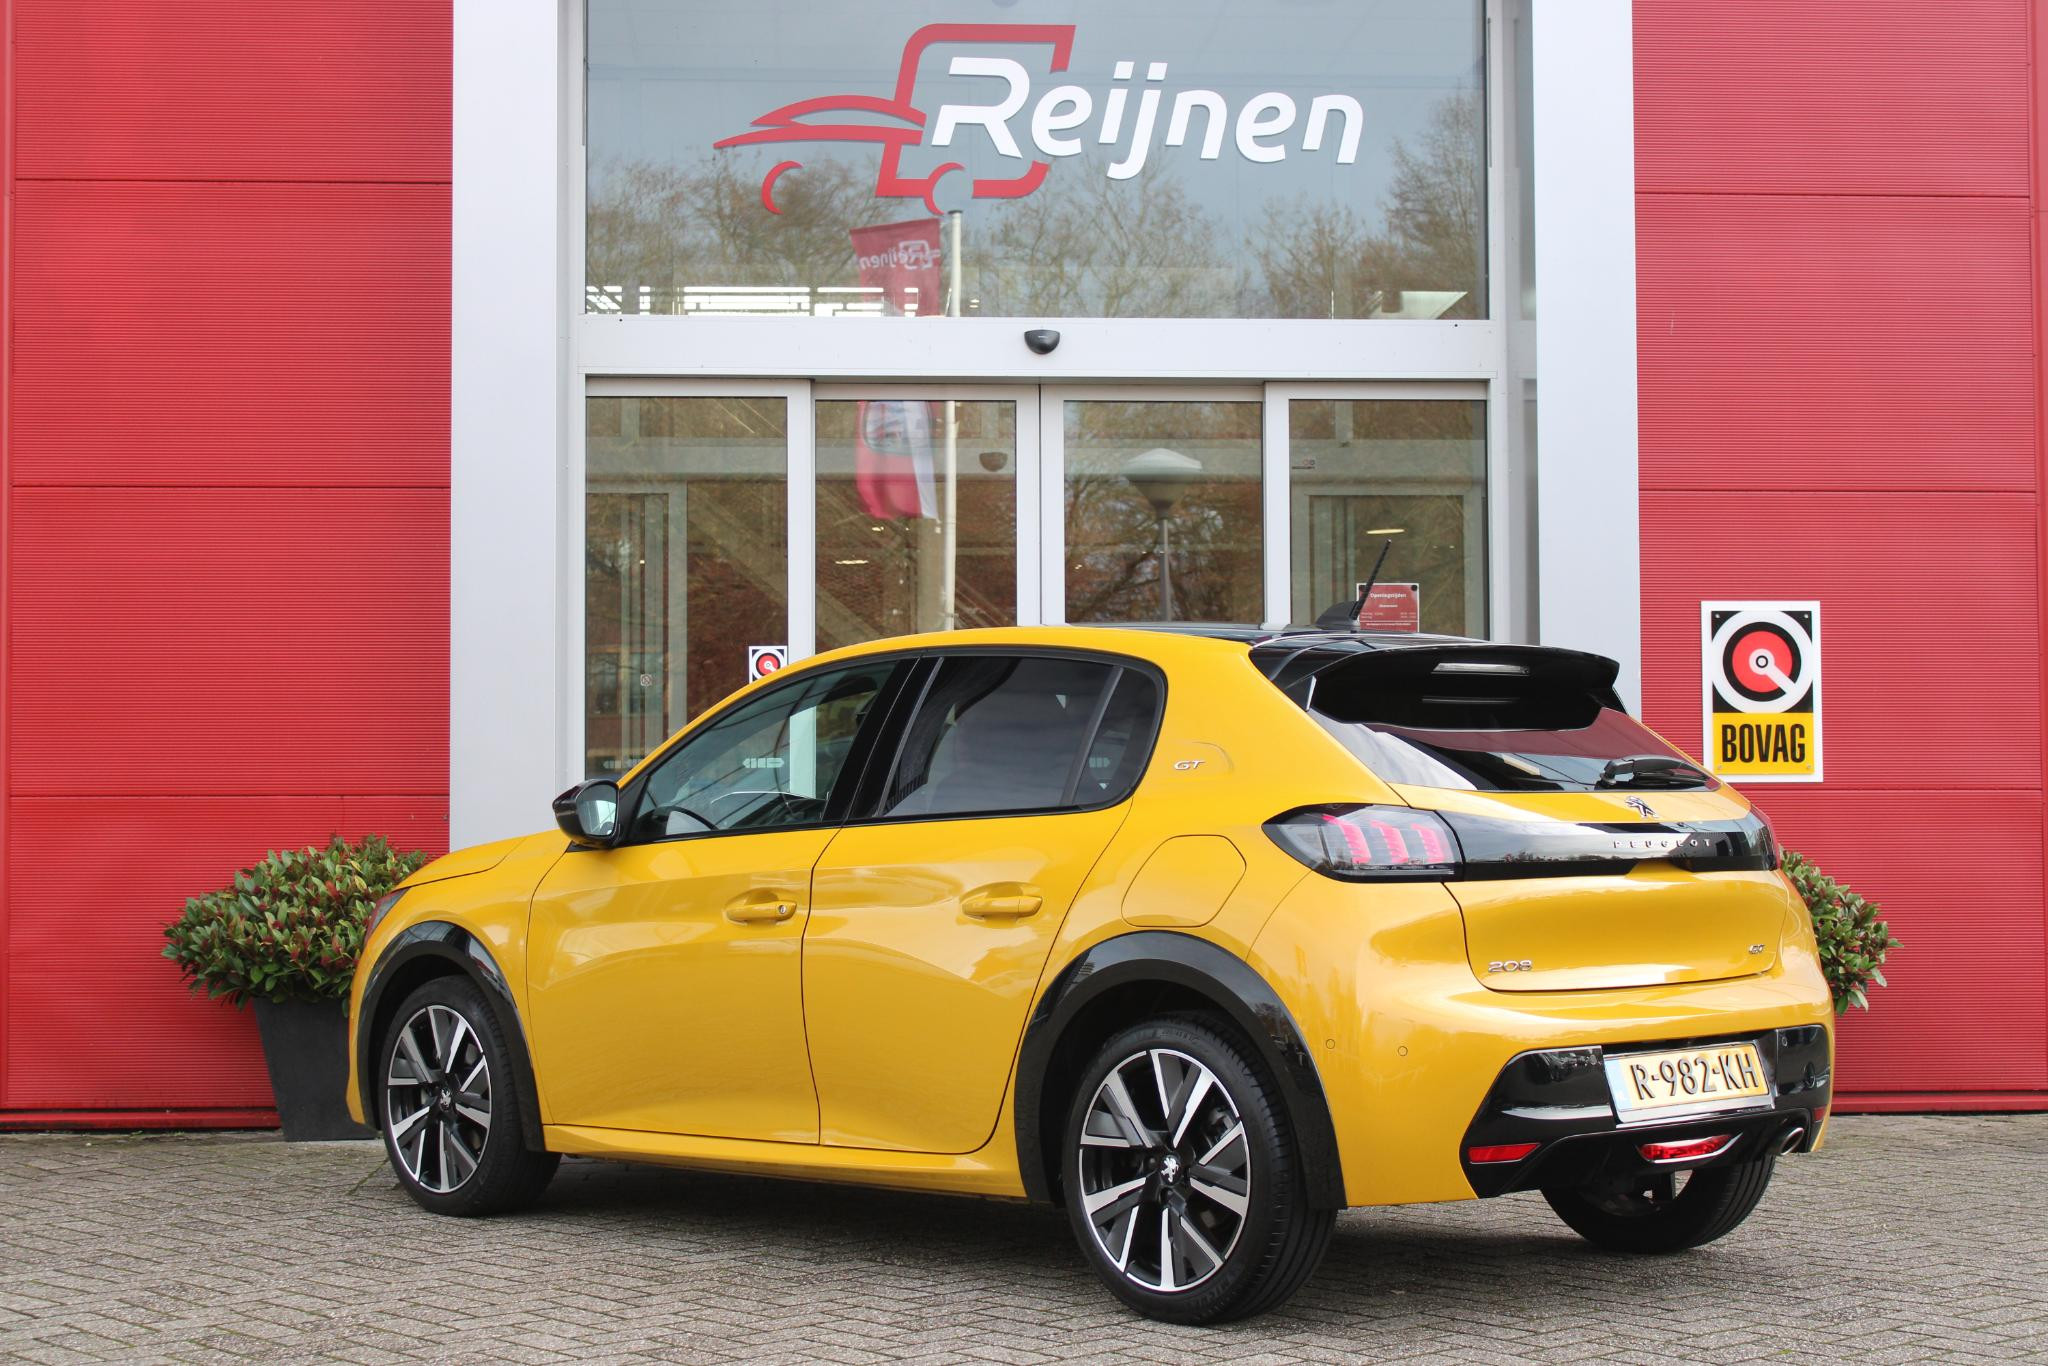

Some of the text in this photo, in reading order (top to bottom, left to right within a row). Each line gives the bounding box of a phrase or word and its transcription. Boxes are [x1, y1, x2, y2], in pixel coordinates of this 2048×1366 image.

[931, 56, 1364, 180] Reijnen
[1721, 723, 1805, 764] BOVAG
[1174, 760, 1206, 771] GT
[1613, 839, 1711, 849] PEUGEOT
[1488, 959, 1532, 973] 208
[1630, 1053, 1759, 1101] R-982-KH
